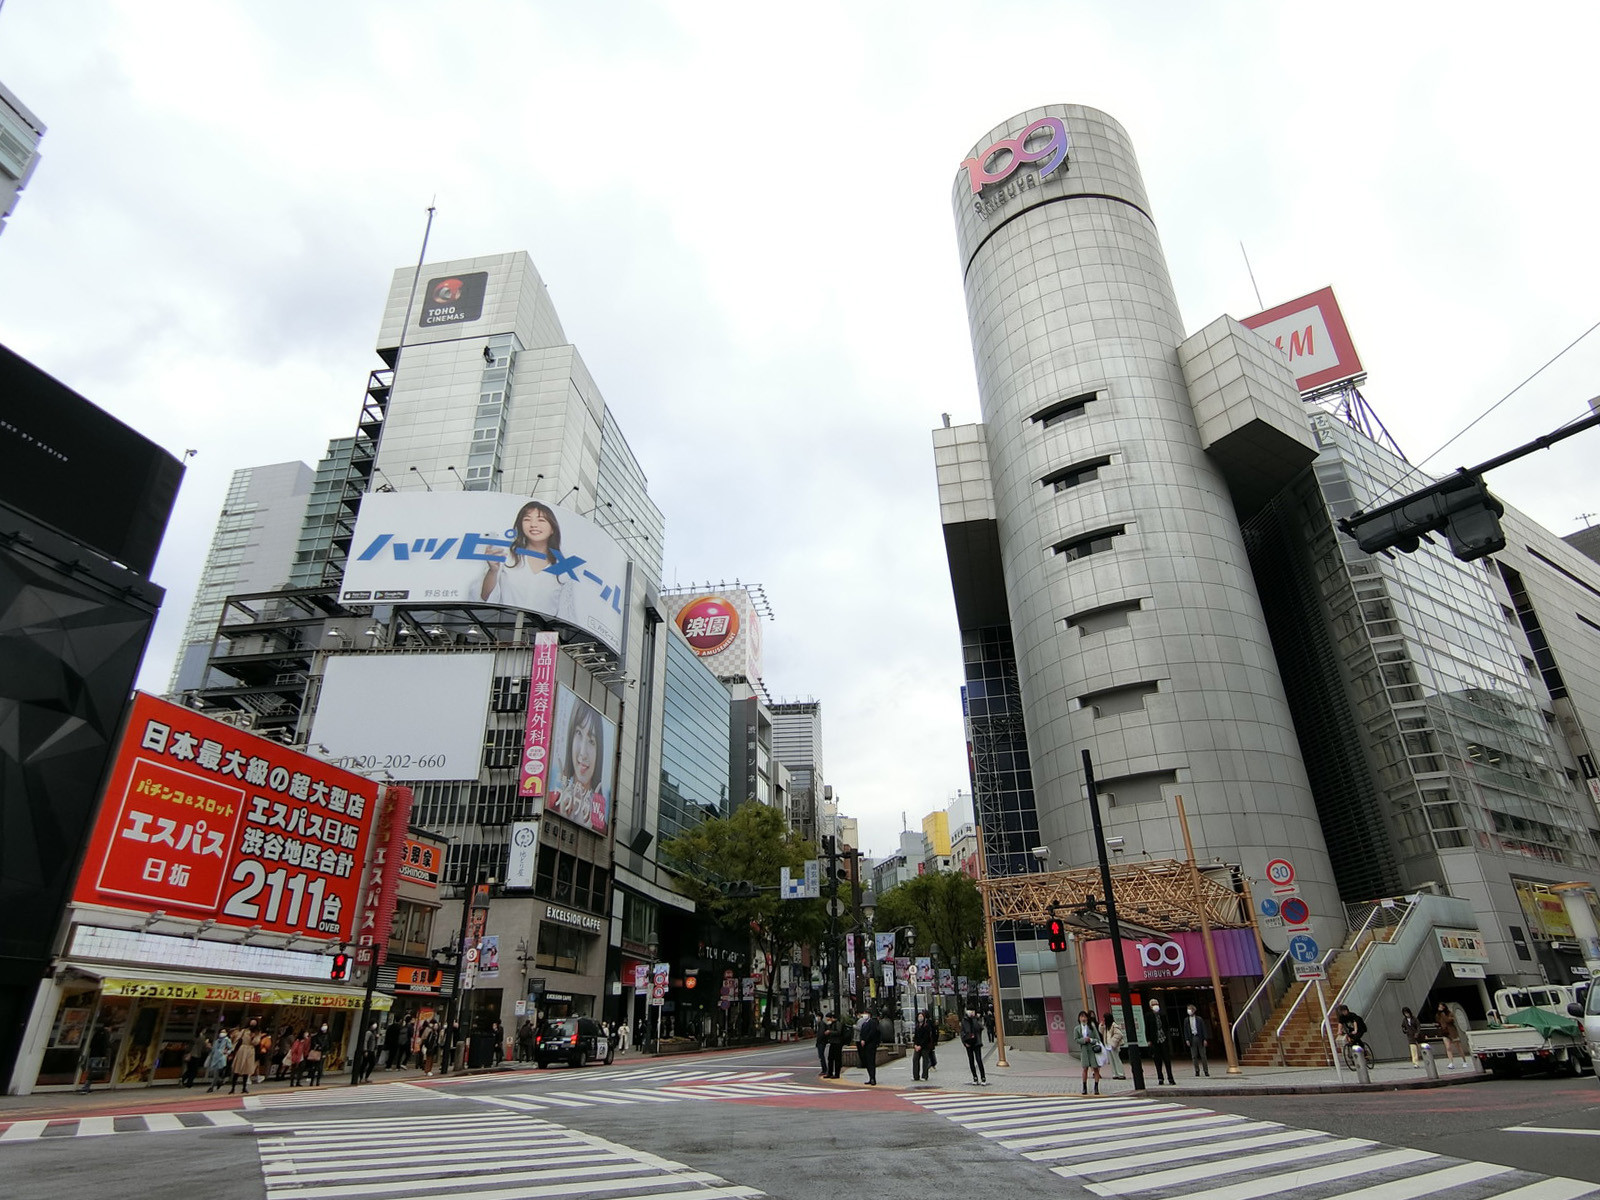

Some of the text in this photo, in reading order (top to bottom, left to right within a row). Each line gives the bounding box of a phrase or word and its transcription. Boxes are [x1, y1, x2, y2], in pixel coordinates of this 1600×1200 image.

[960, 116, 1069, 195] 109
[426, 312, 465, 324] CINEMAS
[428, 306, 456, 317] TOHO
[357, 528, 622, 615] ハッピーメール
[685, 615, 730, 638] 楽園
[702, 632, 736, 656] AMUSEMENT
[529, 652, 552, 745] 品川美容外科
[141, 719, 366, 819] 日本最大級の超大型店
[136, 778, 234, 818] パチンコ&スロット
[246, 795, 360, 849] エスパス日拓
[122, 810, 226, 860] エスパス
[240, 827, 355, 878] 渋谷地区合計
[142, 857, 193, 888] 日拓
[1272, 866, 1289, 879] 30
[318, 921, 340, 934] OVER
[546, 906, 581, 925] EXCELSIOR
[468, 950, 476, 960] 3
[1135, 940, 1186, 977] 109
[1295, 942, 1307, 960] P
[1143, 969, 1172, 979] SHIBUYA
[205, 986, 240, 1000] エスパス
